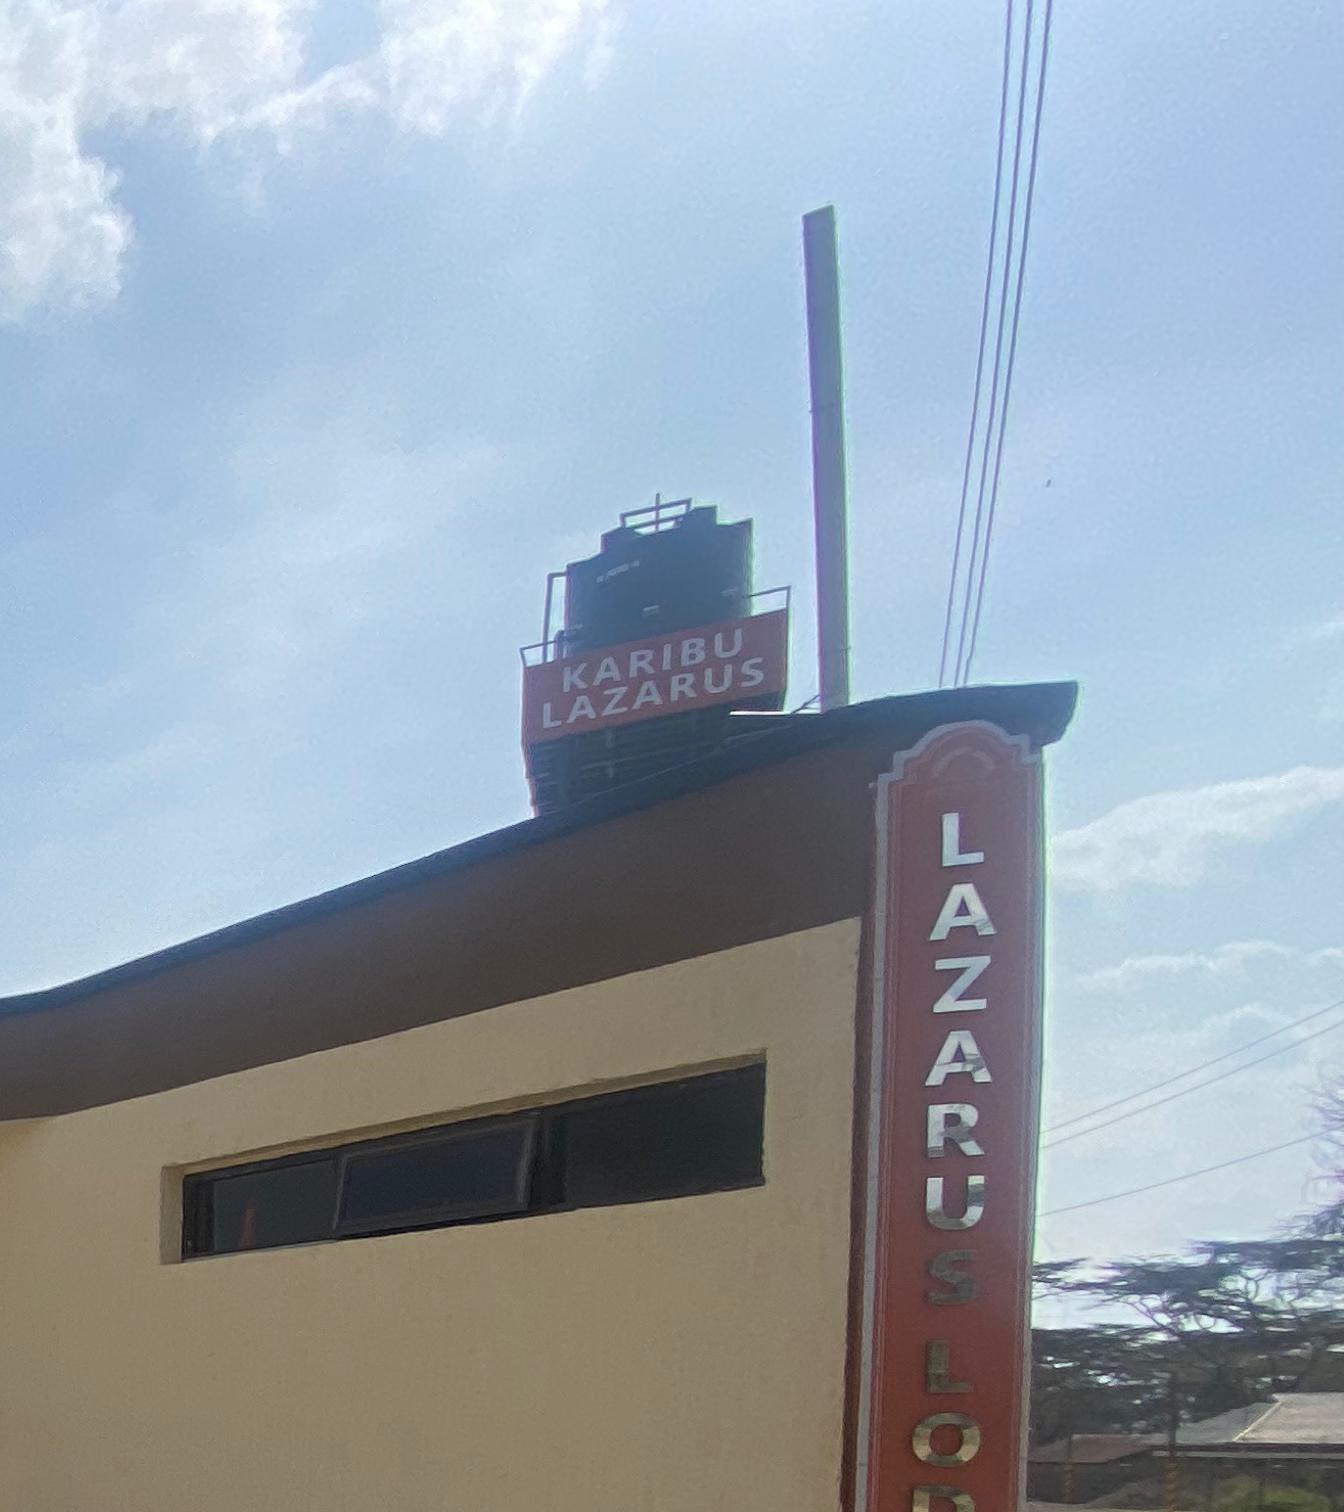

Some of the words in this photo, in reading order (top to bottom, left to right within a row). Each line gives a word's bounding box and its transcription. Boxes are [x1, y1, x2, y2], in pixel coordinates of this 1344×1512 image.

[541, 656, 765, 729] LAZARUS
[562, 628, 743, 692] KARIBU
[924, 812, 998, 1307] LAZARUS
